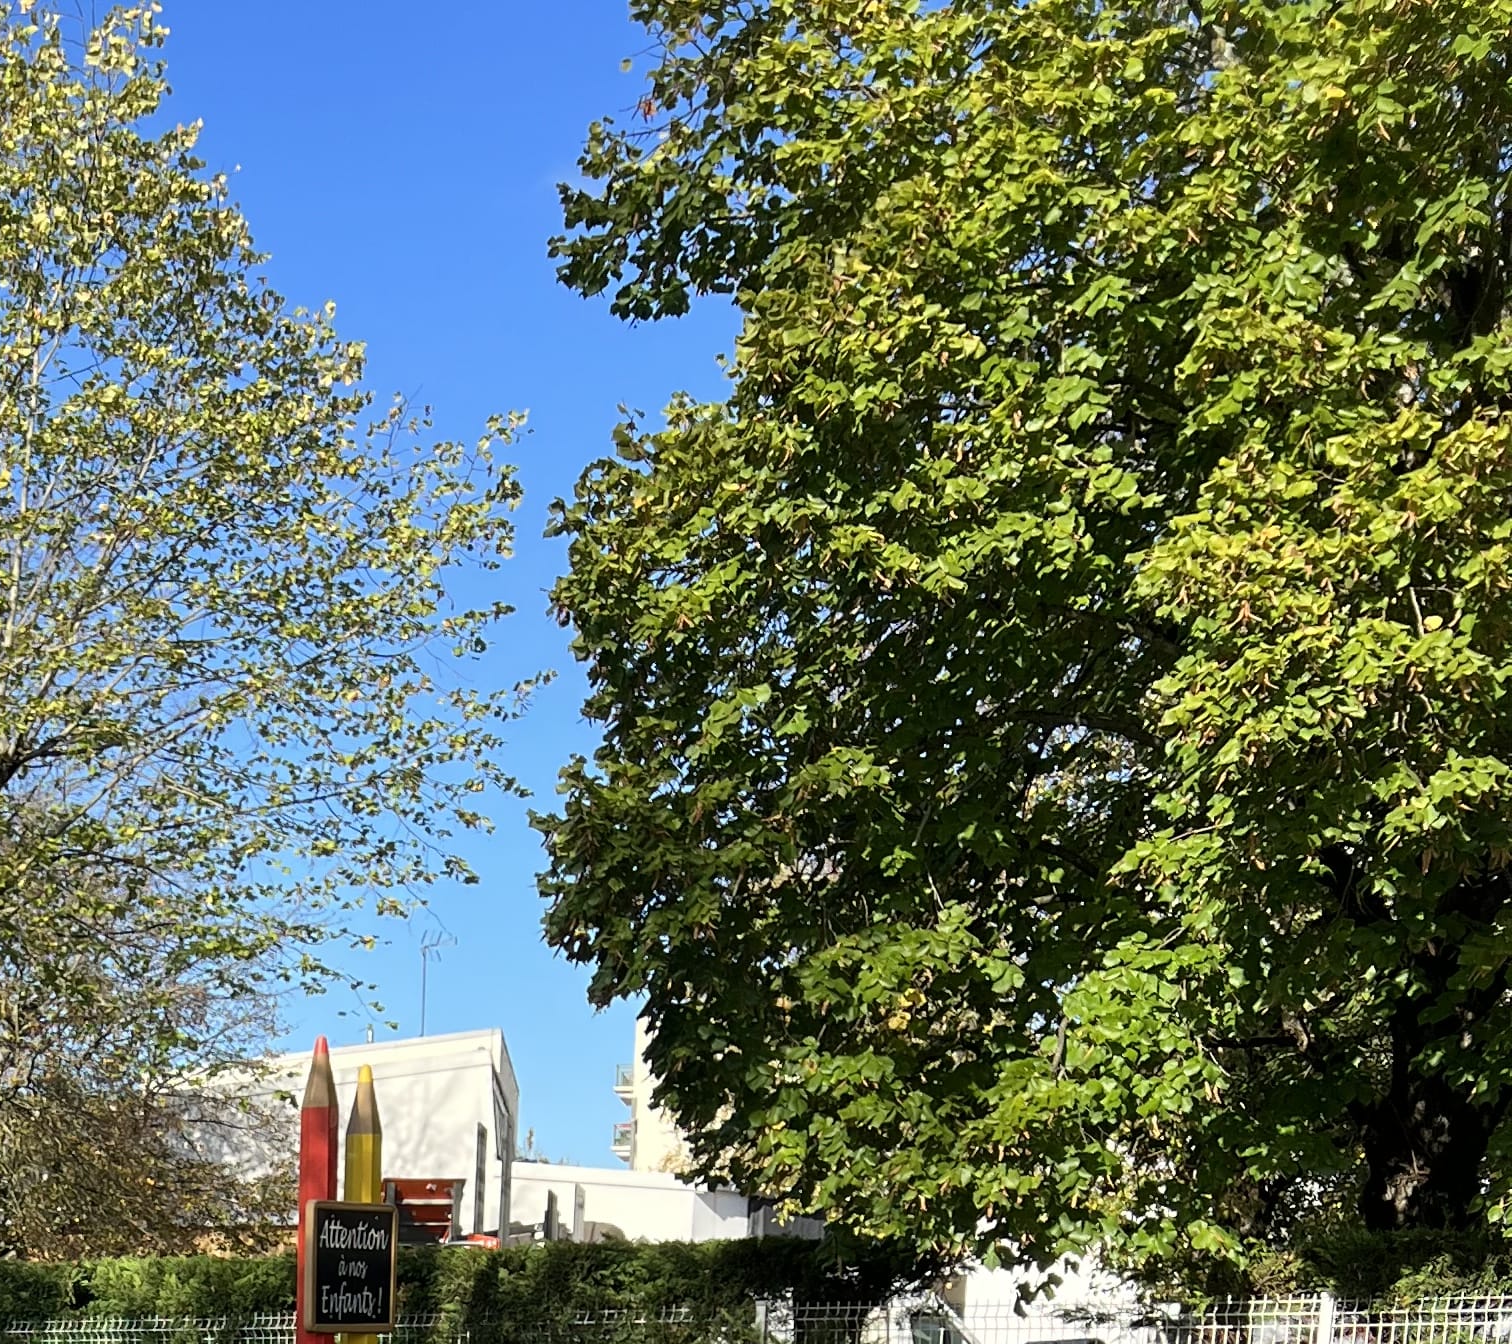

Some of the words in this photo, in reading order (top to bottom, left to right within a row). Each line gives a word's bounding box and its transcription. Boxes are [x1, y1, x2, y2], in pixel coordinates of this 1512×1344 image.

[319, 1215, 389, 1250] Attention
[338, 1254, 347, 1277] à
[348, 1258, 368, 1279] nos
